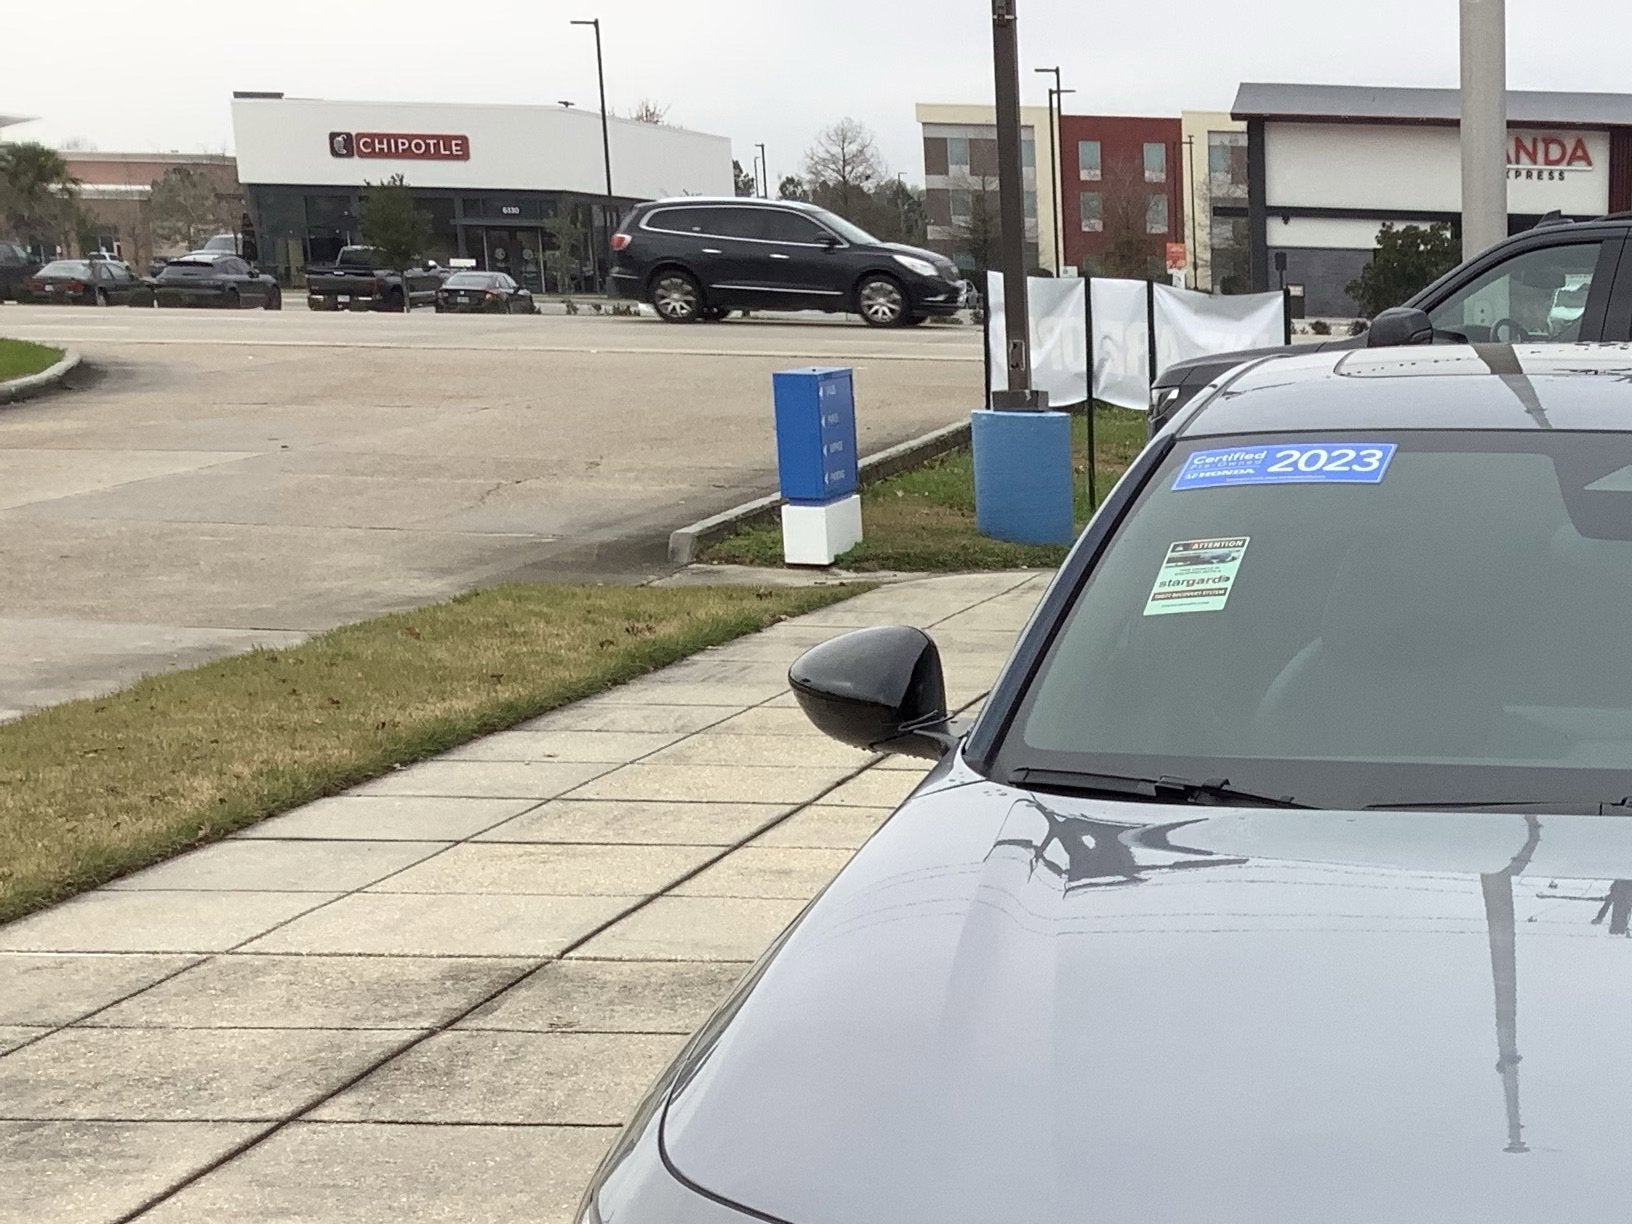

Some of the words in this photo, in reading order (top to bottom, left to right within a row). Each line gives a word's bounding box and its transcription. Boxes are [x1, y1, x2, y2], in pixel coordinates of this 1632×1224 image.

[359, 137, 464, 155] CHIPOTLE
[1506, 136, 1593, 166] NDA
[1194, 450, 1267, 464] Certified
[1267, 449, 1384, 473] 2023
[1191, 540, 1244, 551] ATTENTION
